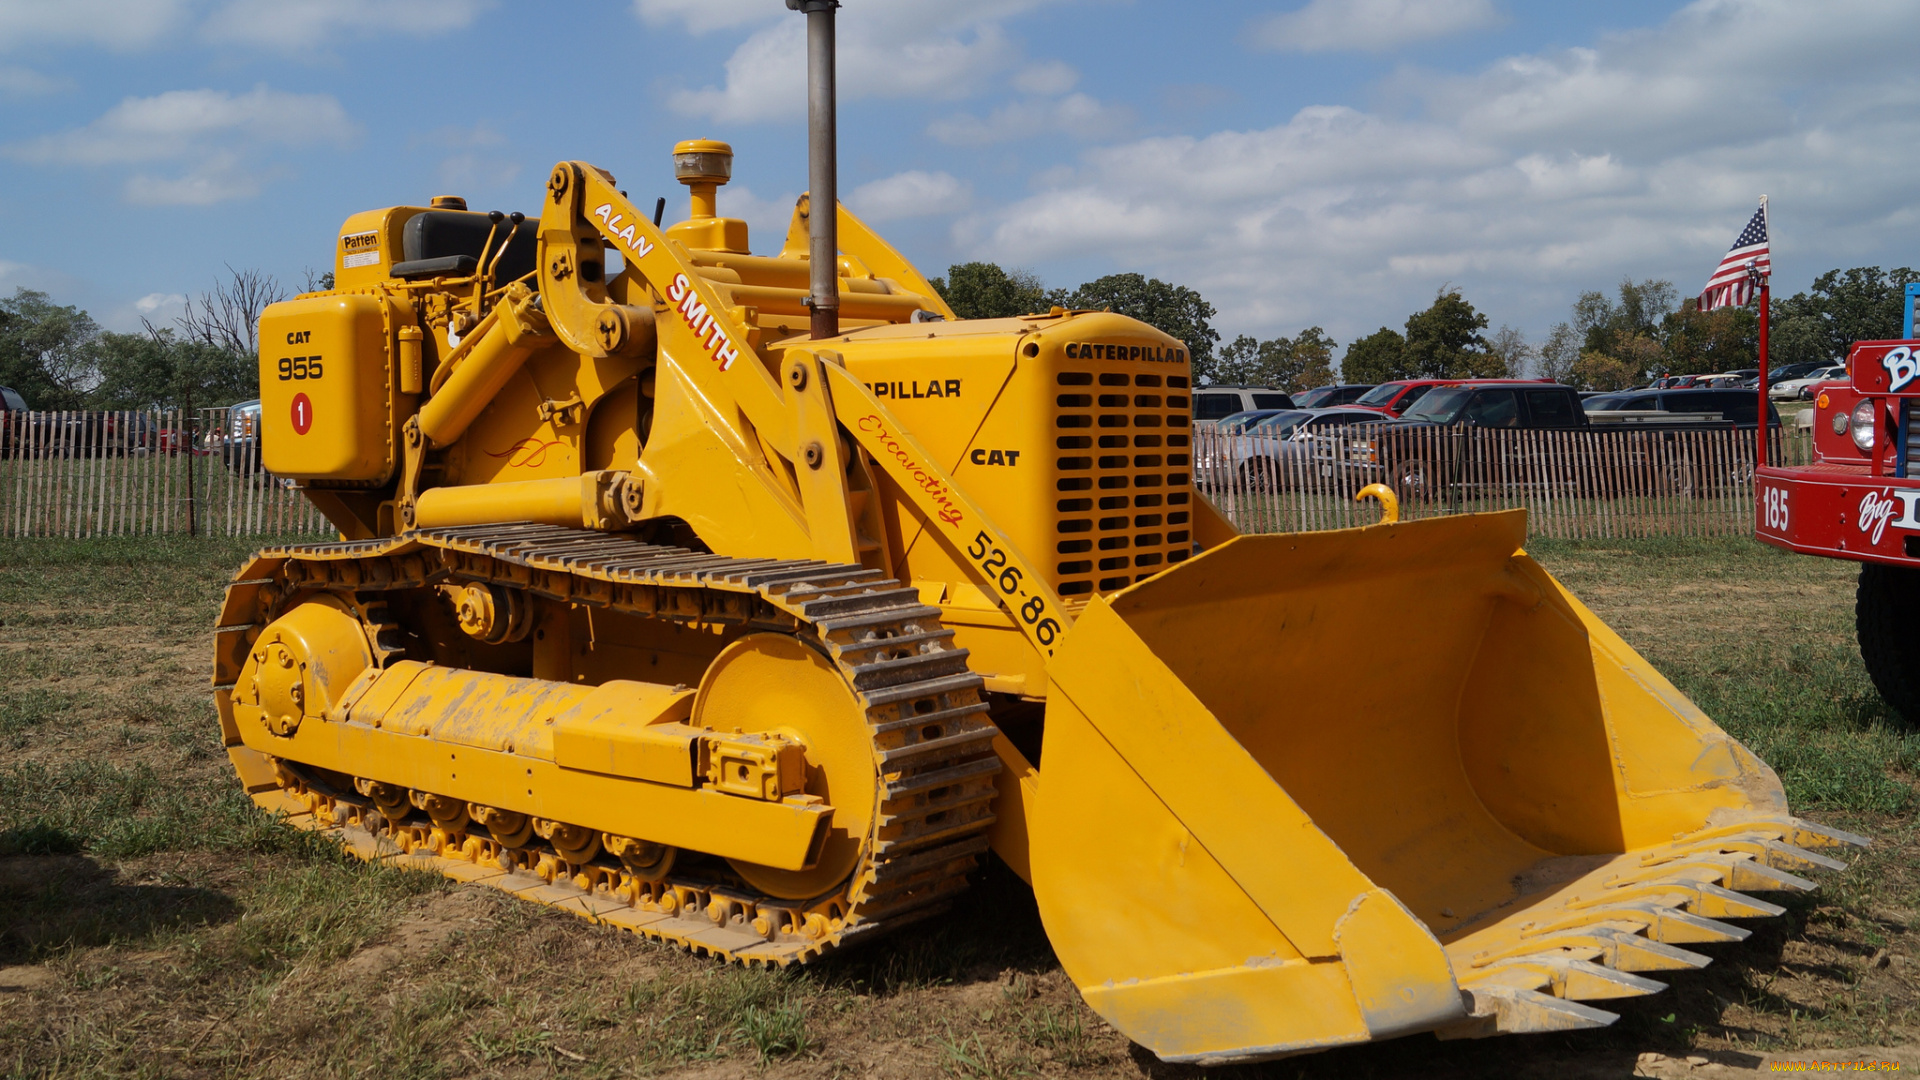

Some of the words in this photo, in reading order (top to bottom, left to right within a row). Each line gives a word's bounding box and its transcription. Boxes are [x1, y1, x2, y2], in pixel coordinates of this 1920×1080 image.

[344, 234, 377, 249] Patten
[595, 203, 654, 259] ALAN
[666, 273, 739, 372] SMITH
[286, 330, 311, 345] CAT
[1064, 341, 1185, 363] CATERPILLAR
[278, 355, 323, 381] 955
[863, 379, 962, 399] PILLAR
[298, 402, 304, 426] 1
[970, 448, 1020, 467] CAT
[858, 414, 963, 529] Excavating
[1763, 486, 1789, 532] 185
[1858, 486, 1898, 546] Big
